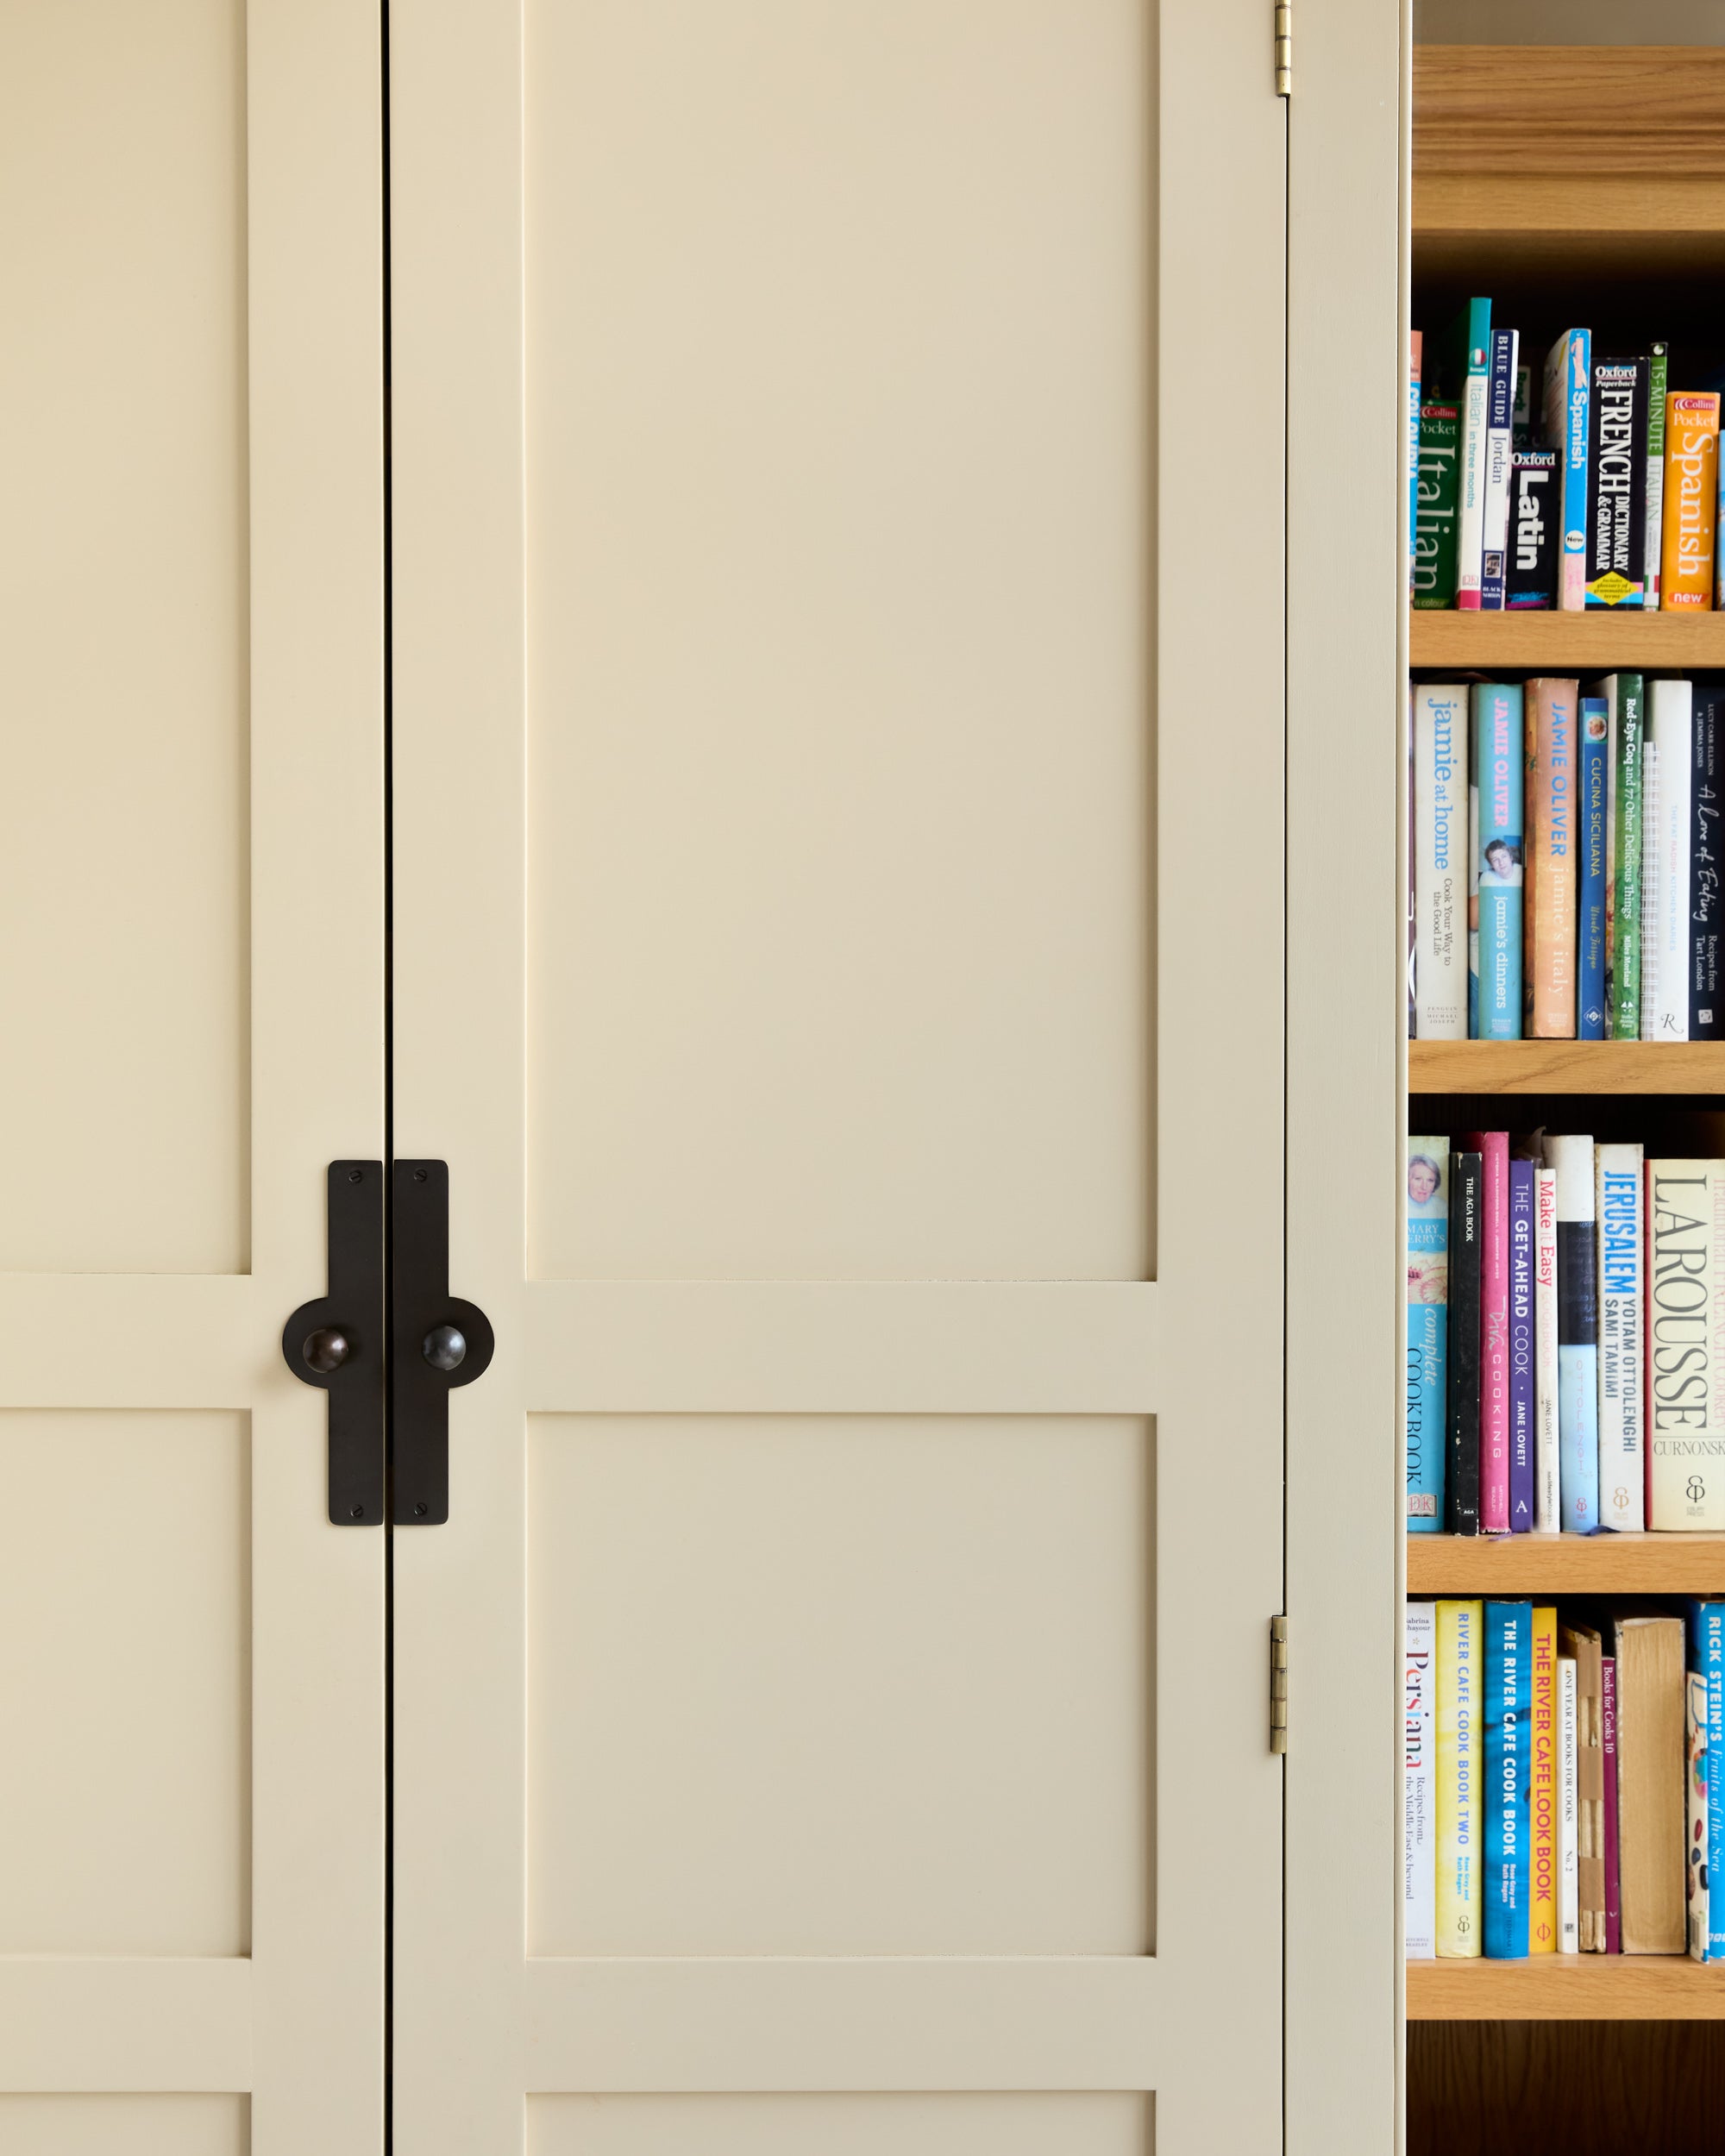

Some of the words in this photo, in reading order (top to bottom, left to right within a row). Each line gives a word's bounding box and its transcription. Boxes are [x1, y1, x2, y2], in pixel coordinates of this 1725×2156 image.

[1496, 335, 1509, 373] BLUE
[1595, 366, 1637, 378] Oxford
[1494, 379, 1507, 424] GUIDE
[1596, 379, 1637, 389] Paperback
[1427, 407, 1457, 417] Collins
[1470, 384, 1484, 427] Italian
[1648, 365, 1665, 450] 15-MINUTE
[1673, 412, 1715, 427] Pocket
[1684, 398, 1715, 410] Collins
[1470, 431, 1480, 441] in
[1570, 391, 1587, 469] Spanish
[1598, 389, 1634, 494] FRENCH
[1469, 442, 1478, 469] three
[1491, 436, 1507, 484] Jordan
[1512, 452, 1555, 467] Oxford
[1466, 472, 1476, 509] months
[1647, 464, 1661, 521] ITALIAN
[1672, 432, 1714, 578] Spanish
[1414, 445, 1456, 590] Italian
[1516, 470, 1549, 570] Latin
[1613, 495, 1630, 571] DICTIONARY
[1673, 592, 1703, 603] new
[1427, 698, 1458, 781] jamie
[1494, 697, 1509, 755] JAMIE
[1551, 702, 1567, 768] JAMIE
[1623, 698, 1636, 743] Red-Eye
[1622, 743, 1636, 765] Coq
[1434, 785, 1448, 802] at
[1494, 759, 1509, 827] OLIVER
[1590, 757, 1602, 809] CUCINA
[1624, 787, 1635, 801] 77
[1625, 766, 1635, 787] and
[1697, 783, 1716, 799] A
[1550, 775, 1567, 856] OLIVER
[1625, 801, 1635, 832] Other
[1434, 805, 1453, 870] home
[1590, 813, 1602, 877] SICILIANA
[1625, 834, 1635, 882] Delicious
[1433, 892, 1442, 907] the
[1444, 877, 1453, 903] Cook
[1549, 863, 1569, 942] jamie's
[1622, 884, 1634, 920] Things
[1433, 909, 1442, 934] Good
[1444, 904, 1453, 930] Your
[1494, 895, 1509, 950] jamie's
[1433, 936, 1442, 956] Life
[1441, 931, 1453, 956] Way
[1444, 956, 1451, 967] to
[1623, 935, 1632, 955] Miles
[1697, 935, 1706, 953] Tart
[1707, 935, 1717, 969] Recipes
[1496, 952, 1509, 1009] dinners
[1548, 951, 1568, 995] italy
[1696, 955, 1706, 991] London
[1707, 972, 1716, 992] from
[1660, 1013, 1684, 1034] R
[1515, 1183, 1528, 1212] THE
[1540, 1181, 1554, 1229] Make
[1408, 1225, 1439, 1234] MARY
[1603, 1170, 1636, 1294] JERUSALEM
[1515, 1219, 1528, 1318] GET-AHEAD
[1536, 1245, 1554, 1287] Easy
[1605, 1299, 1618, 1337] SAMI
[1653, 1174, 1709, 1430] LAROUSSE
[1622, 1299, 1636, 1349] YOTAM
[1419, 1307, 1442, 1387] complete
[1515, 1326, 1528, 1375] COOK
[1605, 1343, 1618, 1398] TAMIMI
[1407, 1348, 1422, 1484] COOKBOOK
[1492, 1354, 1502, 1458] COOKING
[1517, 1401, 1526, 1426] JANE
[1576, 1360, 1584, 1476] OTTOLENGHI
[1622, 1355, 1636, 1452] OTTOLENGHI
[1516, 1429, 1526, 1466] LOVETT
[1408, 1496, 1433, 1512] DK
[1515, 1500, 1528, 1514] A
[1458, 1613, 1470, 1659] RIVER
[1503, 1620, 1516, 1651] THE
[1536, 1633, 1551, 1671] THE
[1709, 1616, 1722, 1663] RICK
[1458, 1666, 1470, 1703] CAFE
[1503, 1658, 1516, 1707] RIVER
[1565, 1670, 1573, 1692] ONE
[1603, 1666, 1614, 1694] Books
[1406, 1651, 1430, 1769] Persiana
[1536, 1676, 1551, 1732] RIVER
[1565, 1693, 1573, 1717] YEAR
[1603, 1695, 1615, 1710] for
[1709, 1670, 1722, 1742] STEIN'S
[1458, 1710, 1470, 1753] COOK
[1503, 1713, 1516, 1752] CAFE
[1565, 1720, 1573, 1730] AT
[1603, 1711, 1615, 1740] Cooks
[1536, 1736, 1551, 1783] CAFE
[1565, 1733, 1573, 1765] BOOKS
[1604, 1743, 1615, 1753] 10
[1458, 1760, 1470, 1803] BOOK
[1503, 1758, 1516, 1803] COOK
[1565, 1767, 1573, 1786] FOR
[1406, 1795, 1414, 1827] Middle
[1414, 1777, 1426, 1816] Recipes
[1536, 1789, 1551, 1841] LOOK
[1565, 1788, 1573, 1822] COOKS
[1708, 1797, 1724, 1814] of
[1406, 1830, 1414, 1852] East
[1458, 1810, 1470, 1845] TWO
[1503, 1809, 1516, 1856] BOOK
[1710, 1817, 1724, 1840] the
[1536, 1847, 1551, 1902] BOOK
[1710, 1845, 1721, 1873] Sea
[1406, 1864, 1414, 1900] beyond
